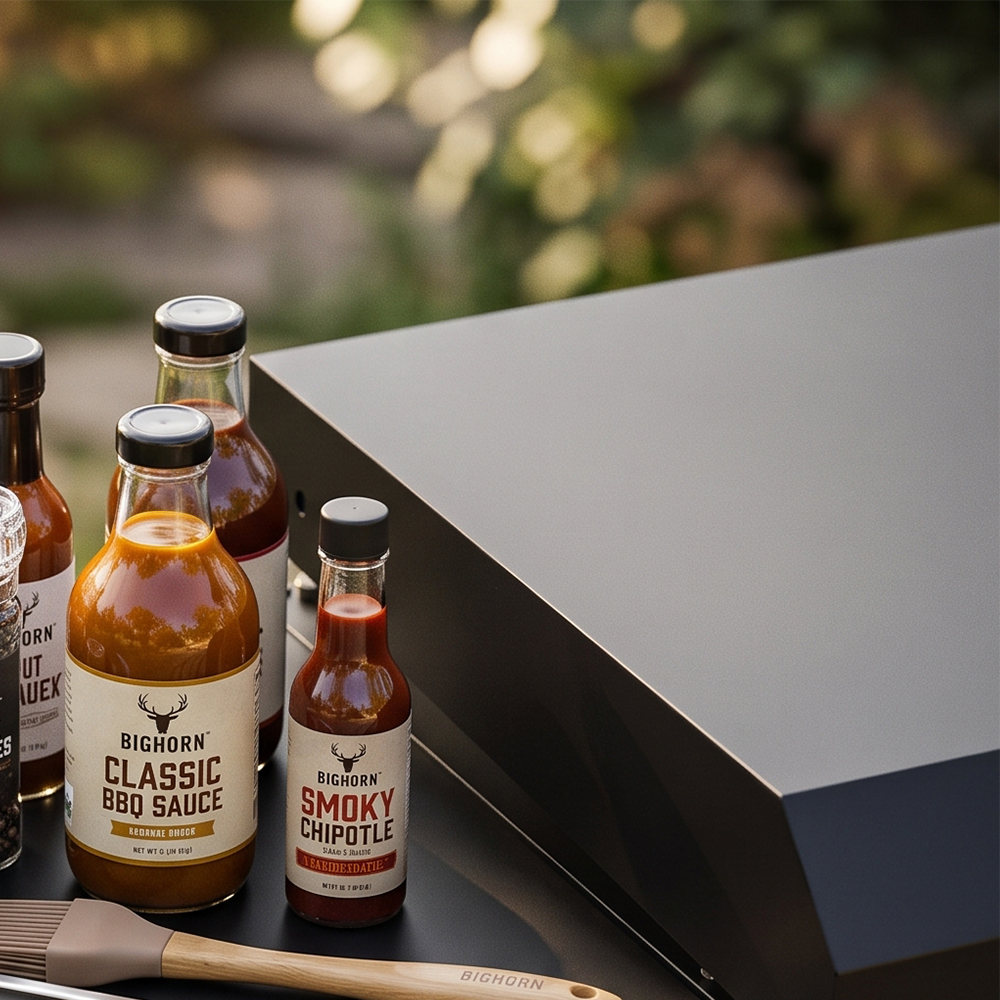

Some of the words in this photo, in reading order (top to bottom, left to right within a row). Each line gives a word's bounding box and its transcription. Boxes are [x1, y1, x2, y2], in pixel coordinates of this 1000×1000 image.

[121, 732, 205, 753] BIGHORN
[105, 755, 221, 791] CLASSIC
[317, 771, 378, 787] BIGHORN
[102, 786, 144, 819] BBQ
[152, 787, 223, 818] SAUCE
[301, 785, 396, 823] SMOKY
[300, 818, 394, 846] CHIPOTLE
[460, 970, 545, 990] BIGHORN
